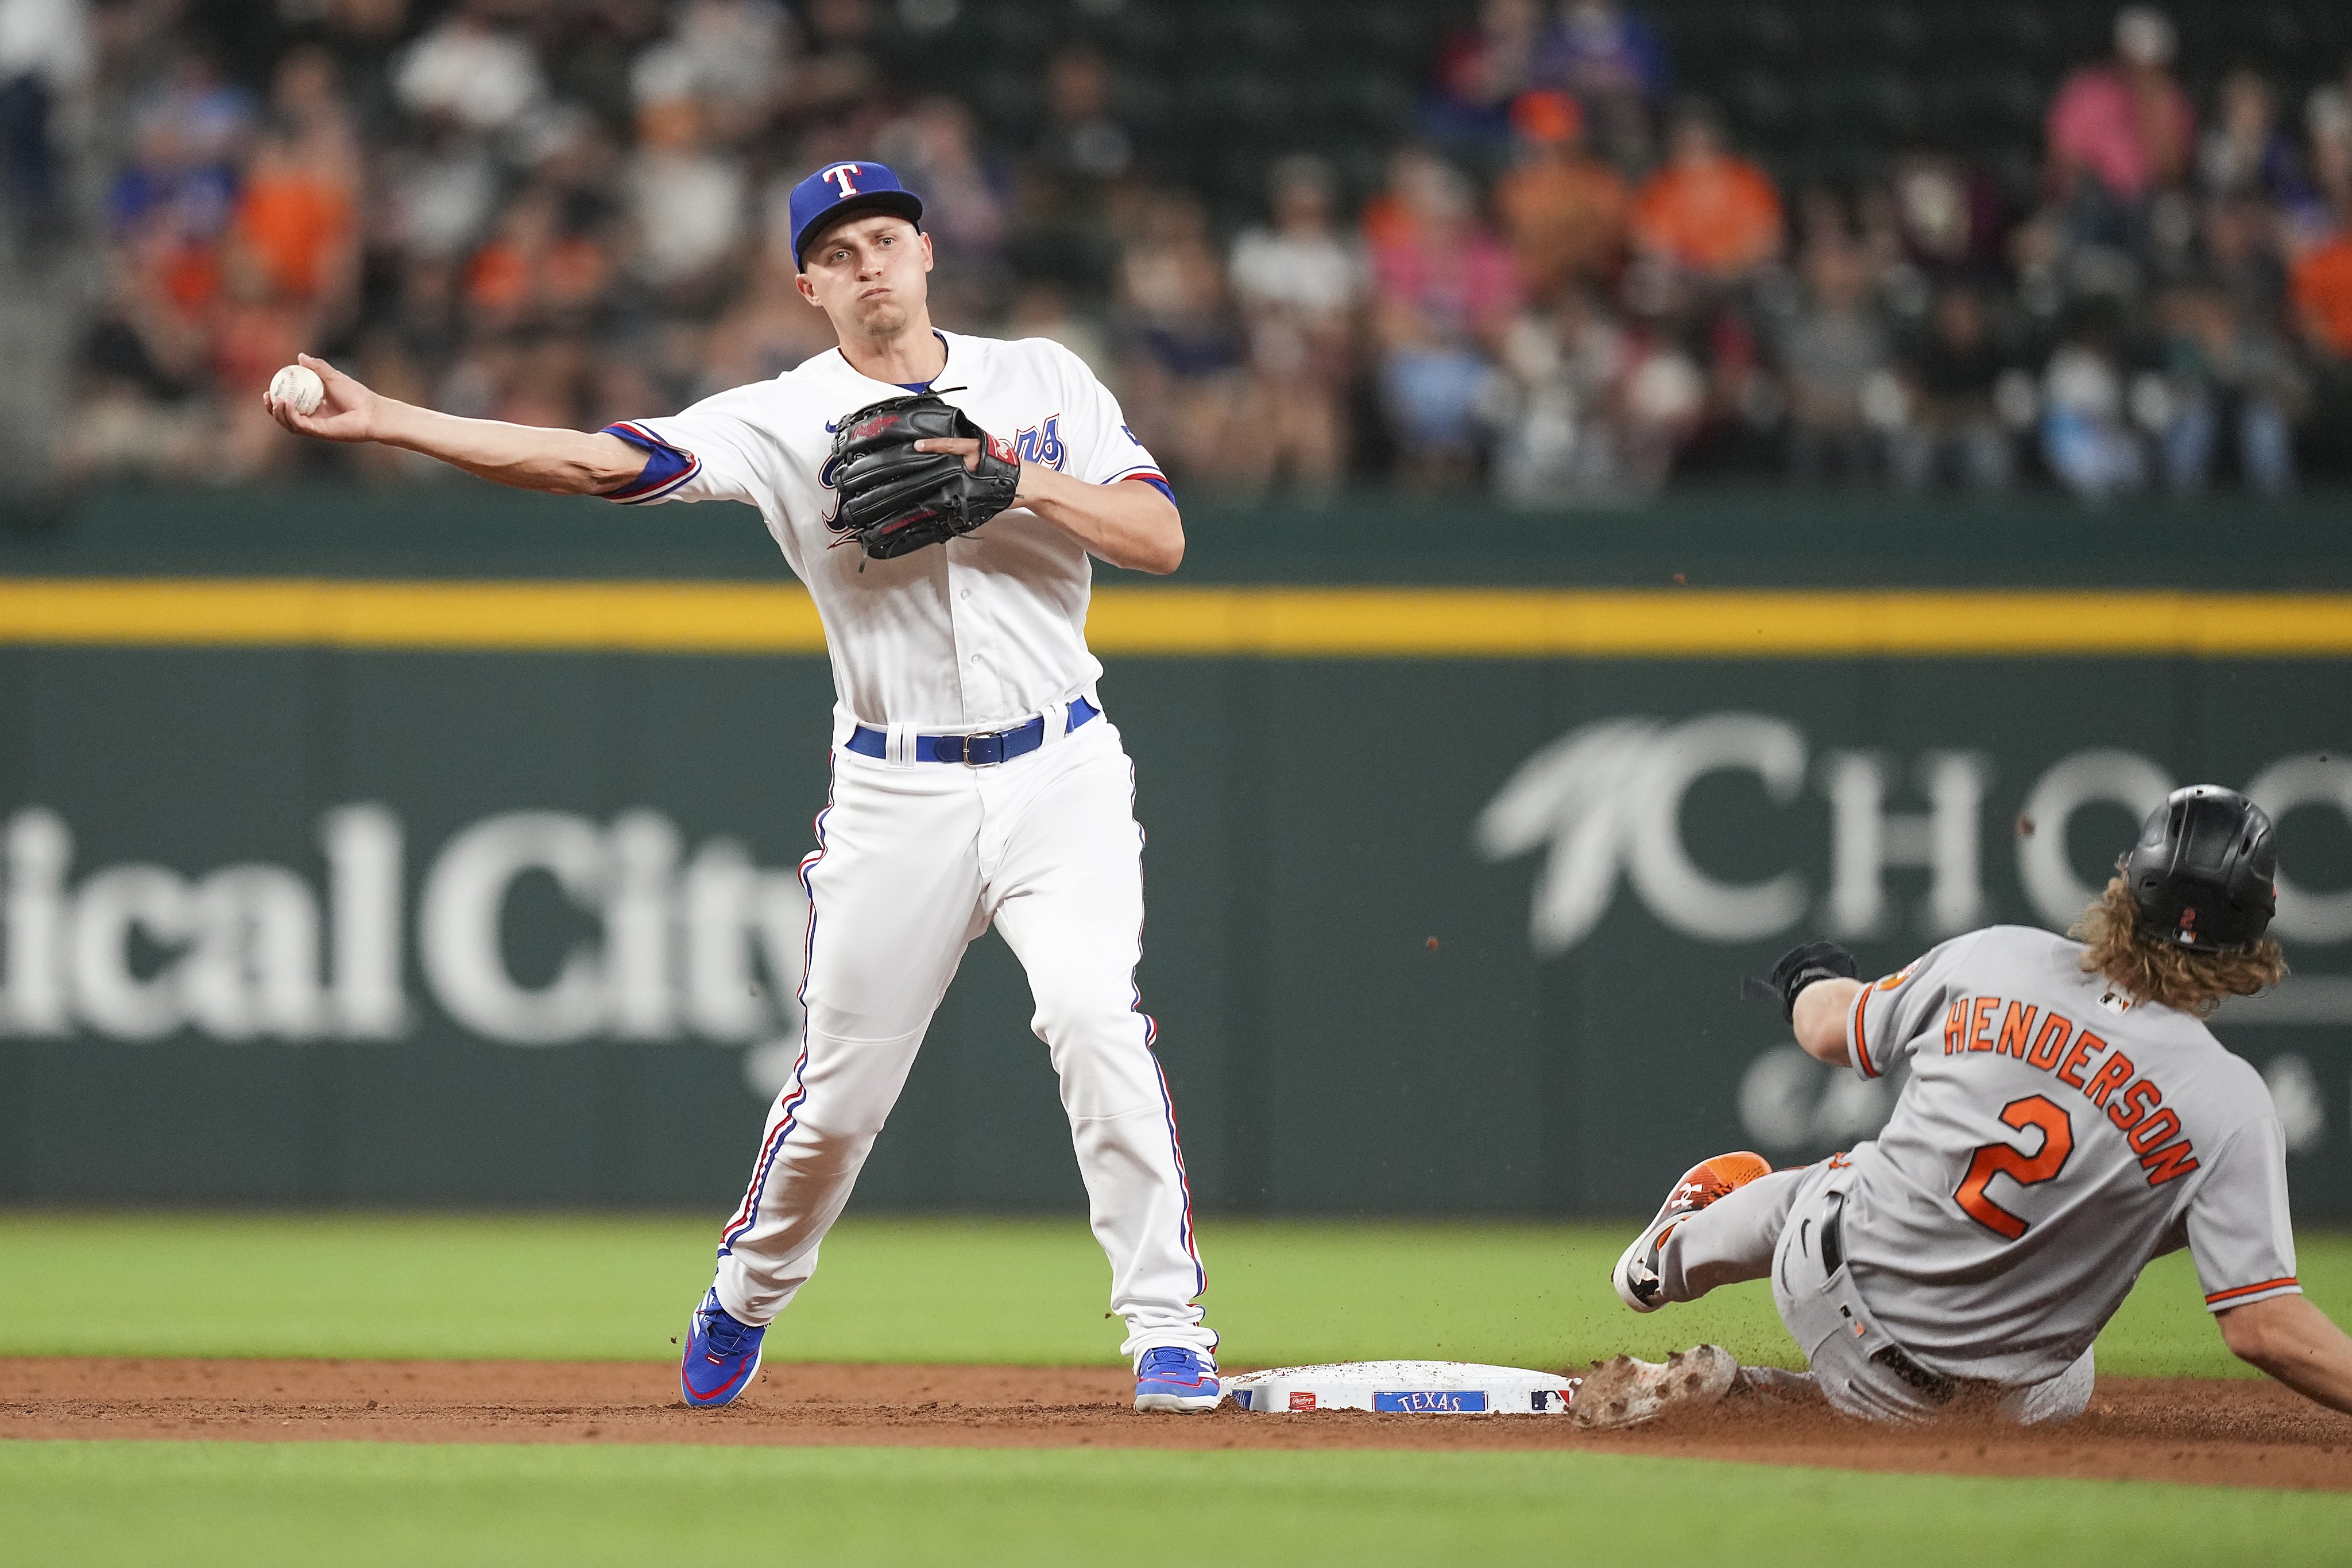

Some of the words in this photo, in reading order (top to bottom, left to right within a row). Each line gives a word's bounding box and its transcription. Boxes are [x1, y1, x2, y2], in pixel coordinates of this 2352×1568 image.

[822, 164, 862, 199] T
[2180, 907, 2196, 930] 2
[1944, 996, 2201, 1189] HENDERSON
[1952, 1094, 2075, 1242] 2
[1292, 1396, 1314, 1404] Rawlings
[1397, 1391, 1462, 1412] TEXAS
